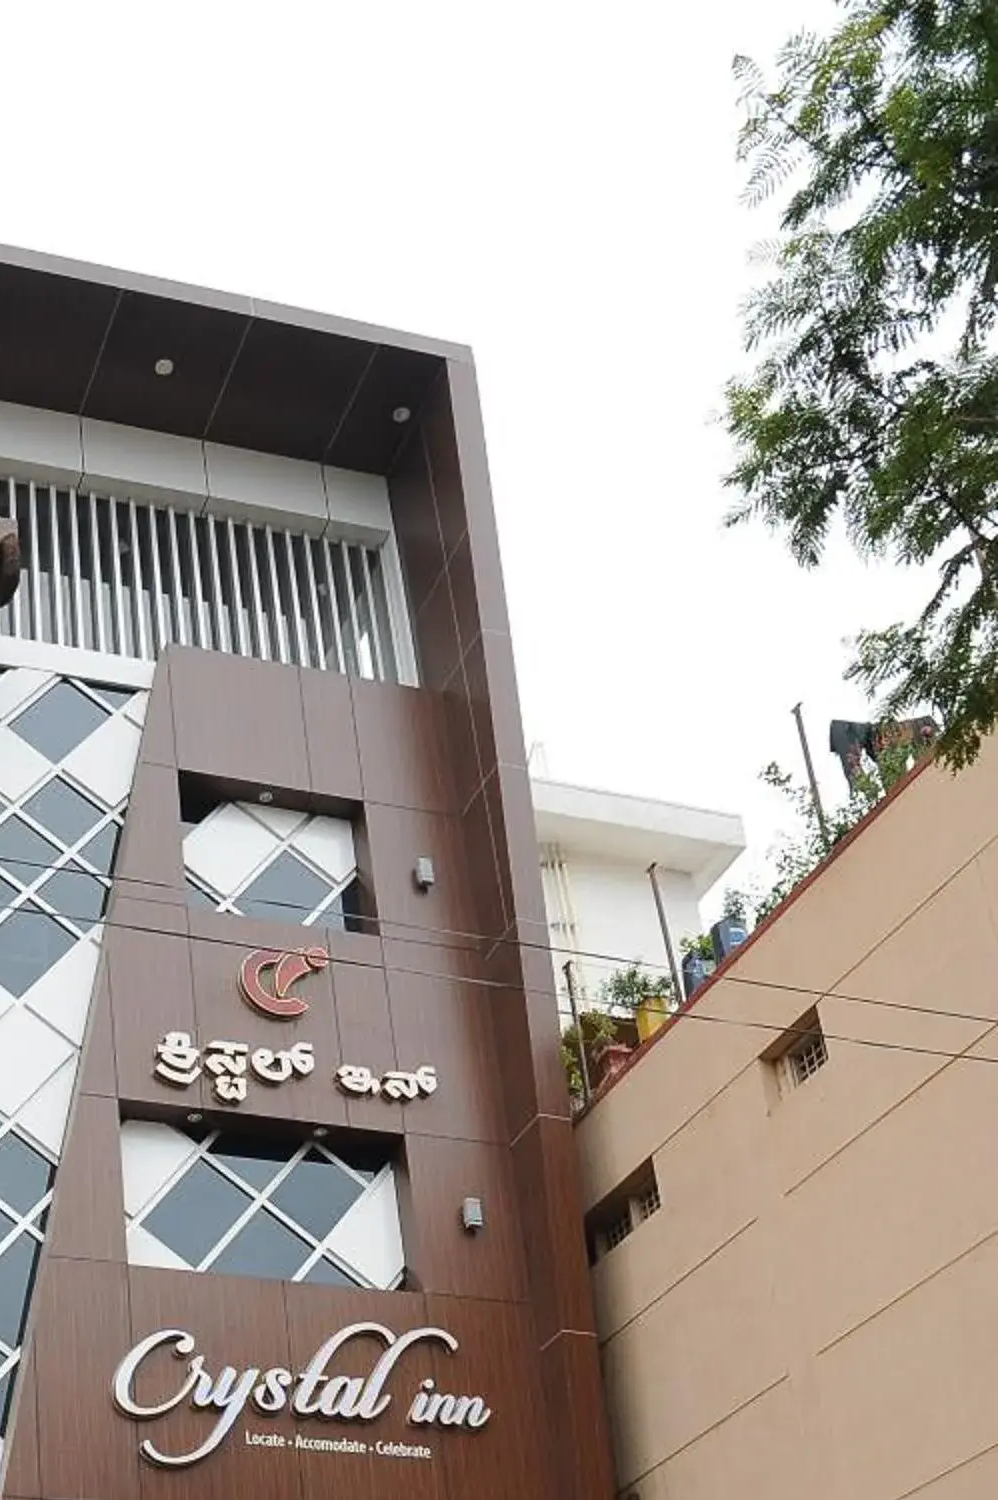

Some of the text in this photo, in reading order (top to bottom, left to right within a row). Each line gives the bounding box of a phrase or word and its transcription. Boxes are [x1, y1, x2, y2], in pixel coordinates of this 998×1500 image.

[153, 1031, 438, 1102] ಕ್ರಿಸ್ಟಲ್ ಇನ್
[114, 1321, 492, 1466] Crystal inn
[245, 1431, 432, 1459] Locate Accomodate Celebrate
